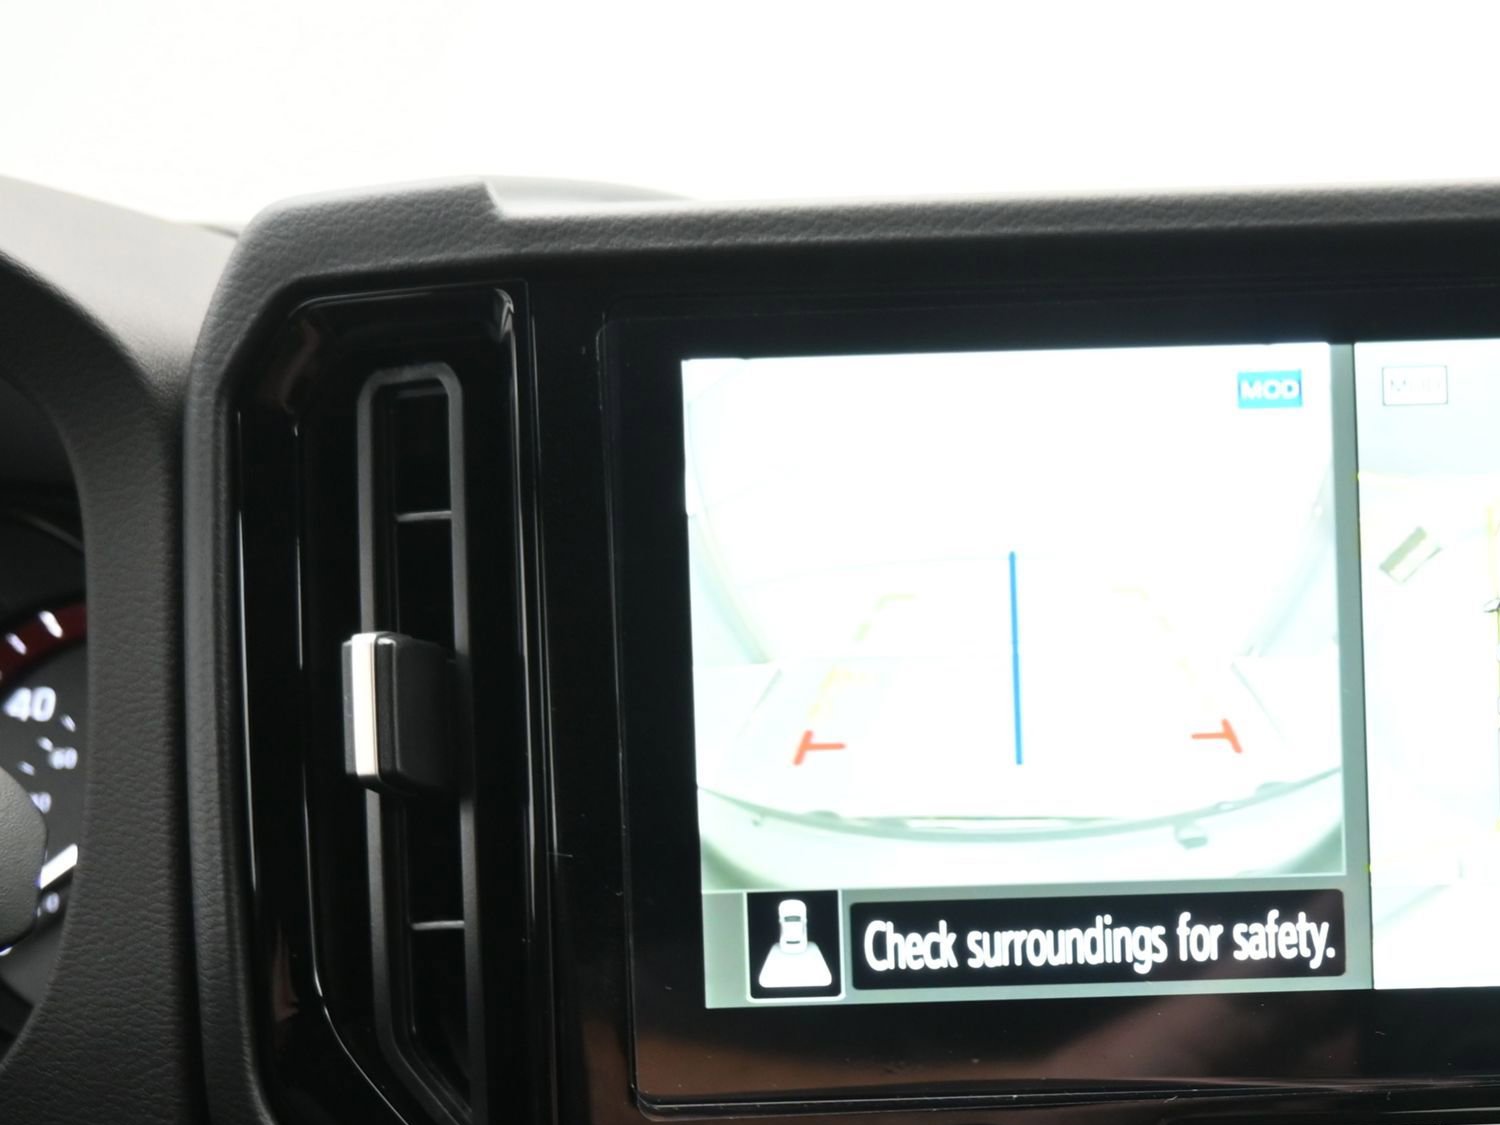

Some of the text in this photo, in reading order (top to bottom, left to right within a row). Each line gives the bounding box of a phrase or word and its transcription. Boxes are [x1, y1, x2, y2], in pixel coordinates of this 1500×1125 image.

[1240, 377, 1300, 400] MOD
[4, 686, 57, 722] 40
[863, 908, 1336, 975] Check surroundings for safety.
